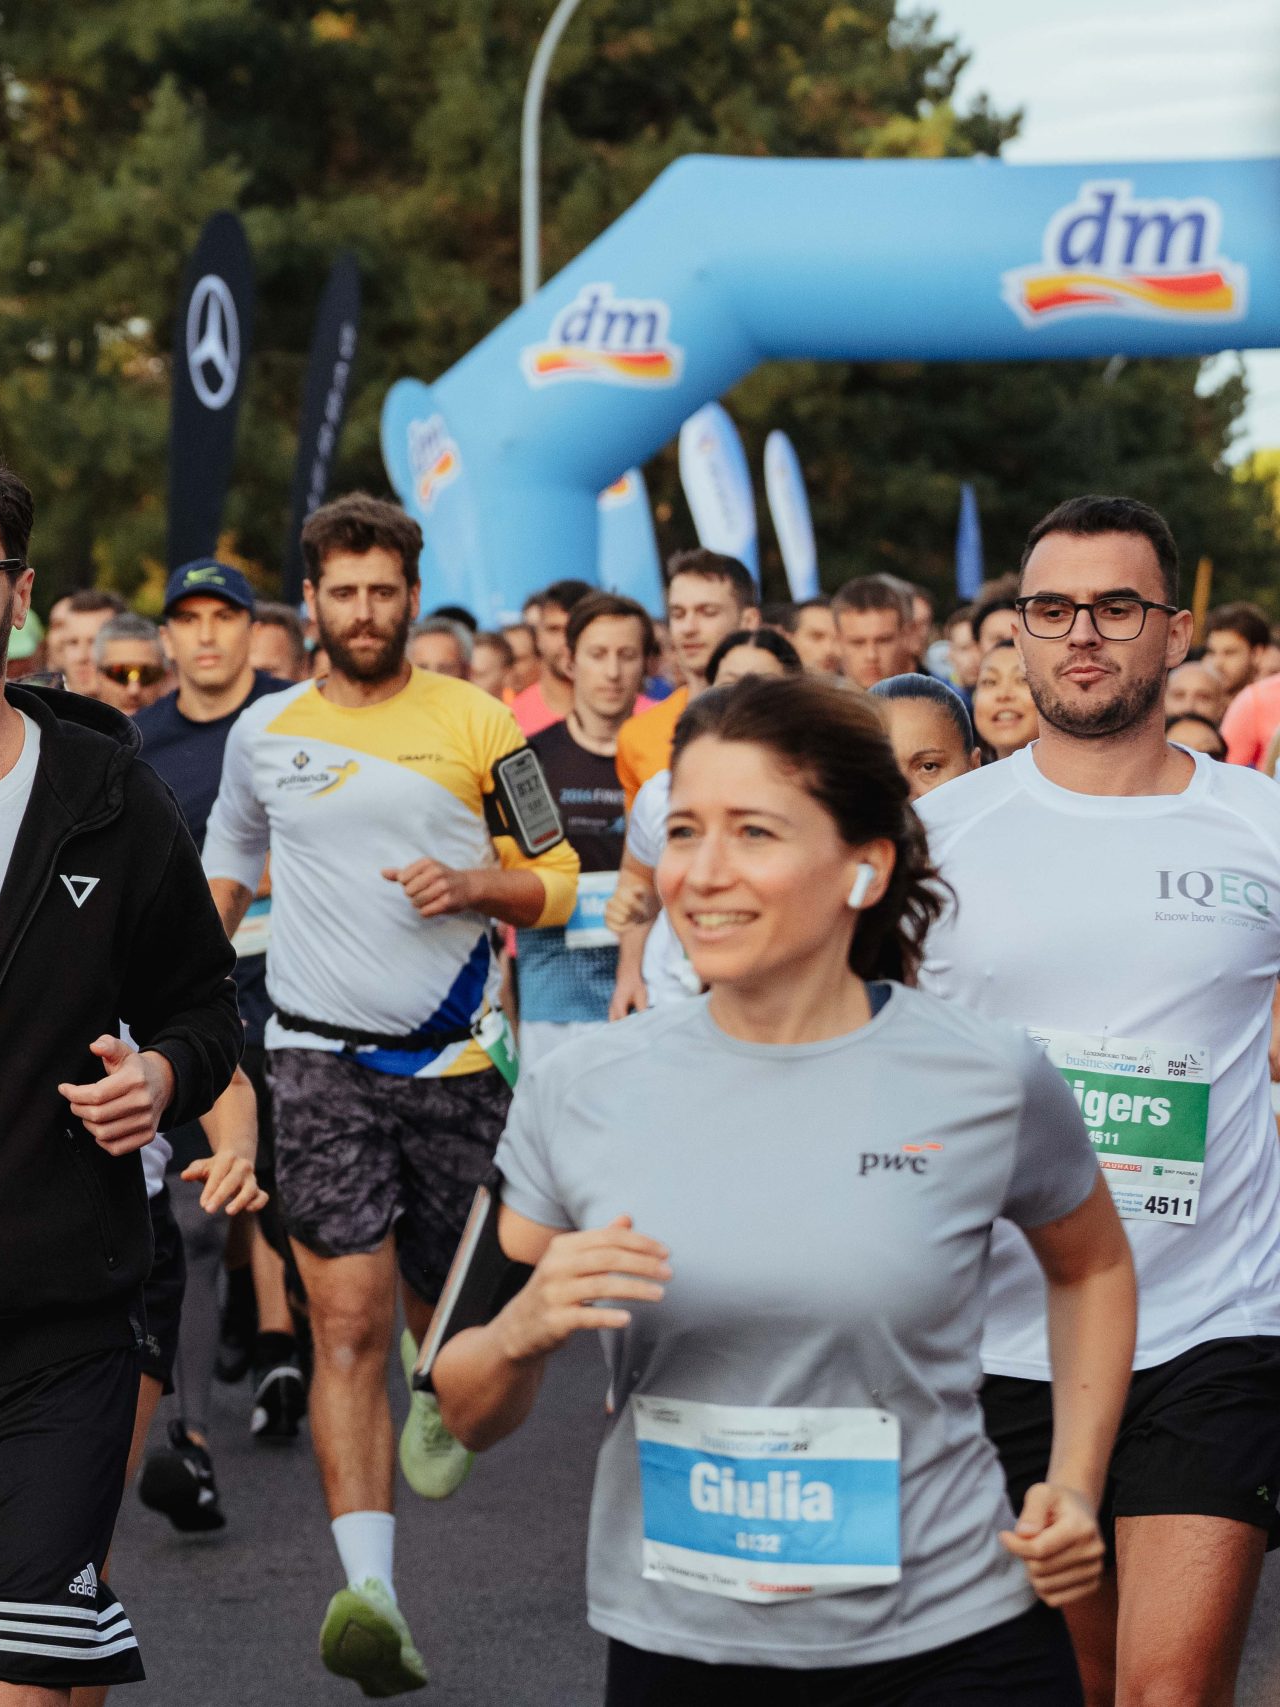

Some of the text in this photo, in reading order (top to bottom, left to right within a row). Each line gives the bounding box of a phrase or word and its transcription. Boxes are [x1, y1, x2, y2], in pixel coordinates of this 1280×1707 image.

[1059, 191, 1206, 266] dm
[561, 294, 658, 344] dm
[1154, 911, 1266, 931] Know how Know you
[1137, 1065, 1151, 1074] 26
[1168, 1060, 1187, 1069] RUN
[1168, 1068, 1186, 1077] FOR
[1064, 1079, 1171, 1127] igers
[1088, 1130, 1119, 1146] 4511
[859, 1152, 928, 1176] pwc
[1144, 1196, 1193, 1217] 4511
[689, 1462, 834, 1522] Giulia
